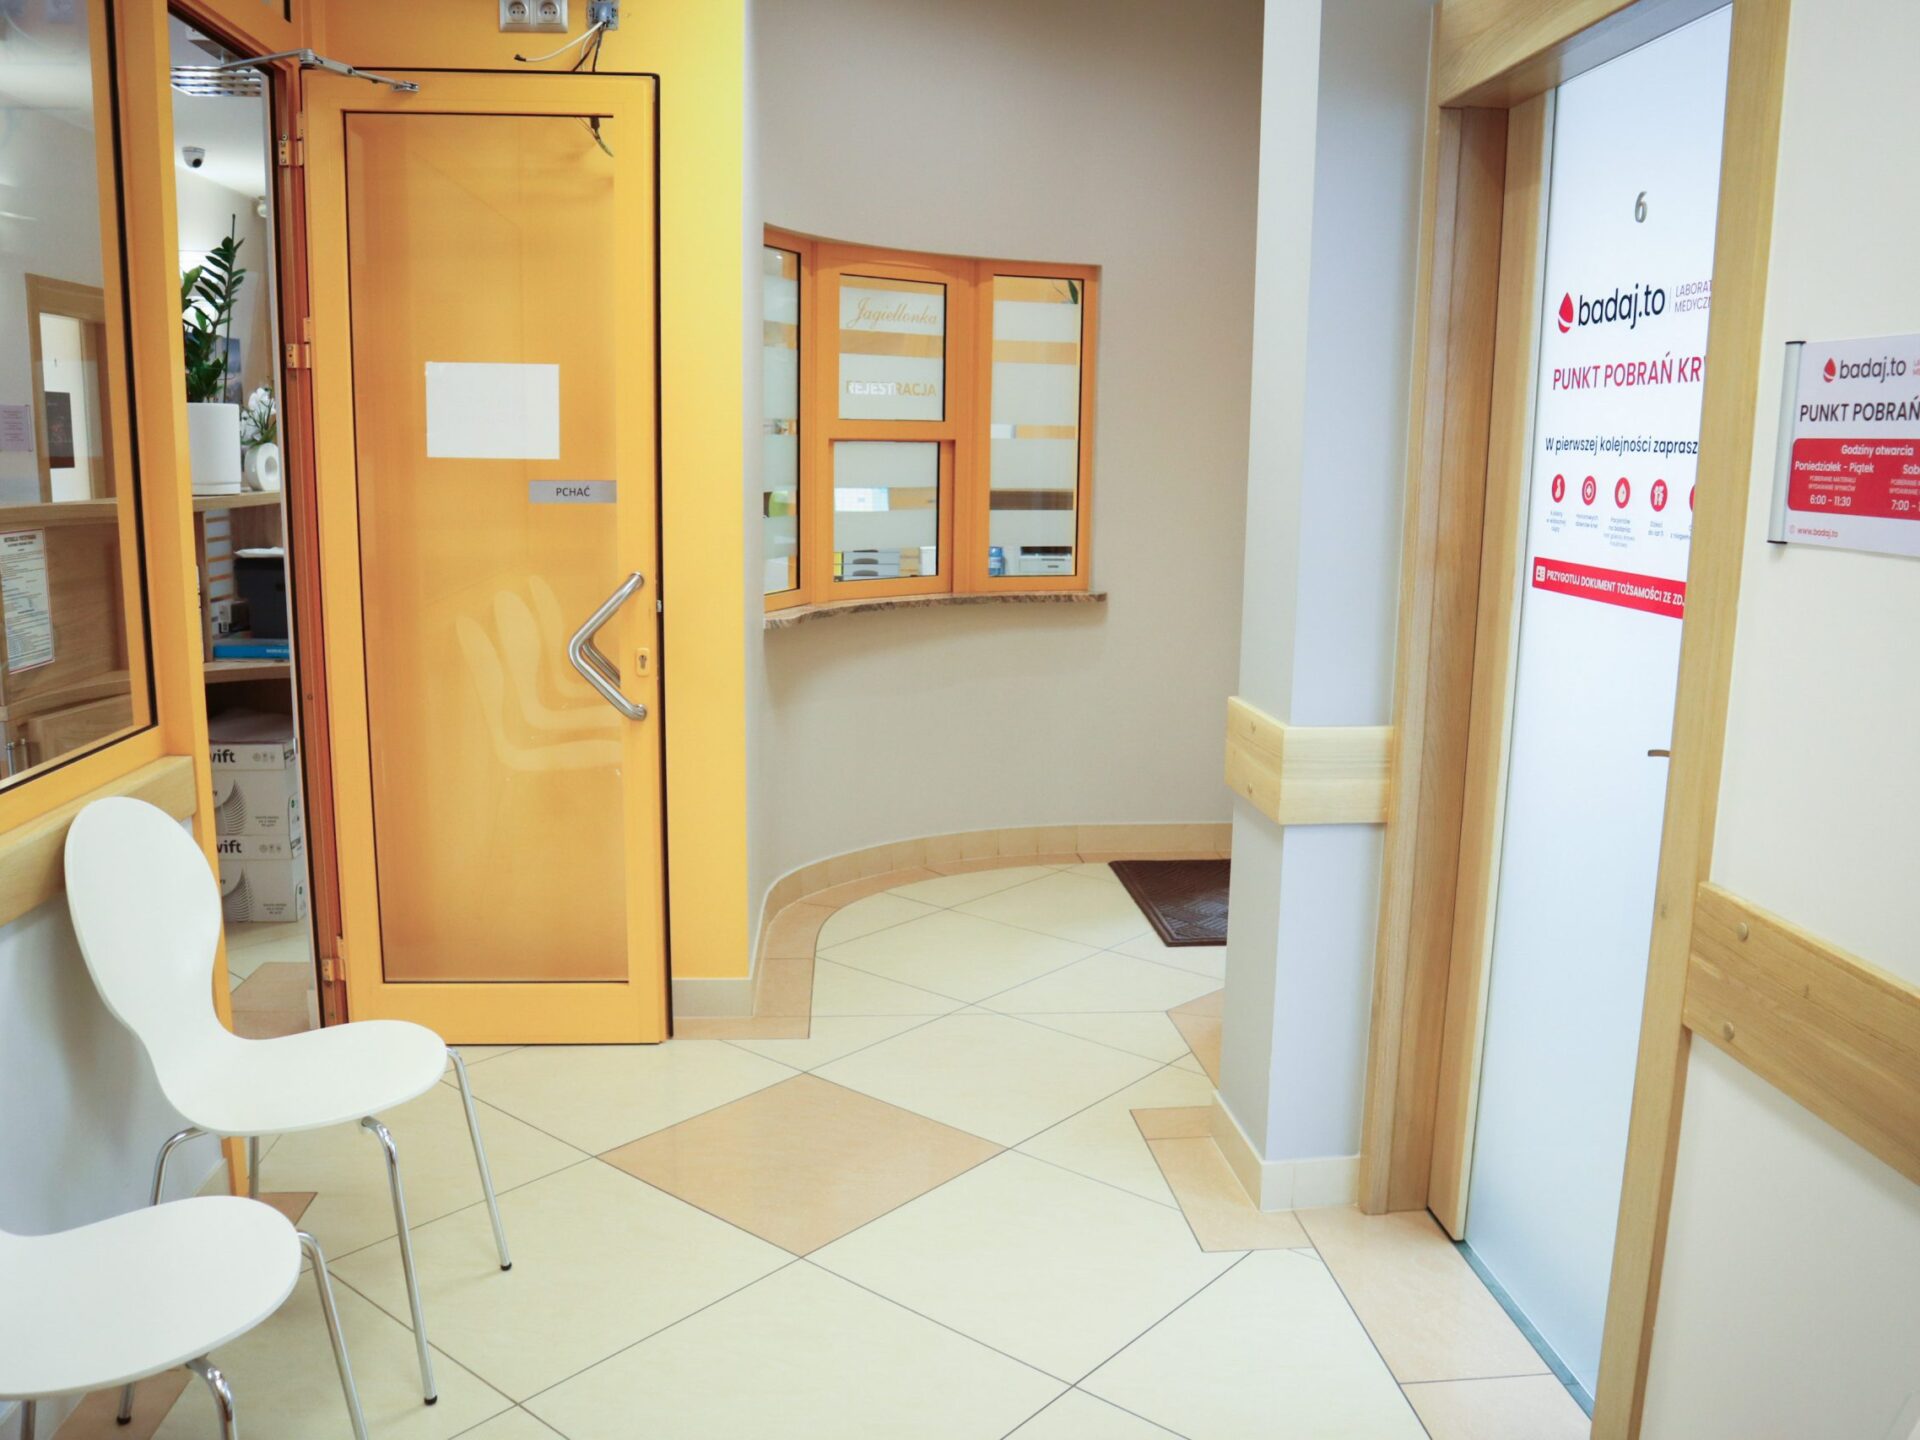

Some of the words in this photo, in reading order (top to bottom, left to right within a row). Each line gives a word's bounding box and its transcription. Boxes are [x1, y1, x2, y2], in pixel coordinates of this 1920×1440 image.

[1634, 191, 1648, 223] 6
[847, 297, 937, 329] Jagiellonka
[1578, 282, 1666, 330] badaj.to
[1552, 365, 1601, 391] PUNKT
[1603, 350, 1674, 388] POBRAŃ
[1677, 355, 1706, 384] KR
[1839, 356, 1907, 384] badaj.to
[845, 379, 937, 398] REJESTRACJA
[1799, 403, 1850, 422] PUNKT
[1852, 395, 1920, 421] POBRAŃ
[1545, 437, 1555, 451] W
[1555, 436, 1599, 456] pierwszej
[1600, 434, 1652, 457] kolejności
[1653, 440, 1699, 459] zaprasz
[1841, 445, 1874, 458] Godziny
[1875, 446, 1914, 456] otwarcia
[1849, 463, 1875, 475] Piątek
[556, 485, 591, 497] PCHAĆ
[1809, 494, 1827, 505] 6:00
[1833, 496, 1852, 507] 11:30
[1891, 499, 1910, 511] 7:00
[1546, 570, 1580, 586] PRZYGOTUJ
[1581, 576, 1616, 593] DOKUMENT
[1617, 581, 1662, 602] TOŻSAMOŚCI
[1662, 590, 1672, 604] ZE
